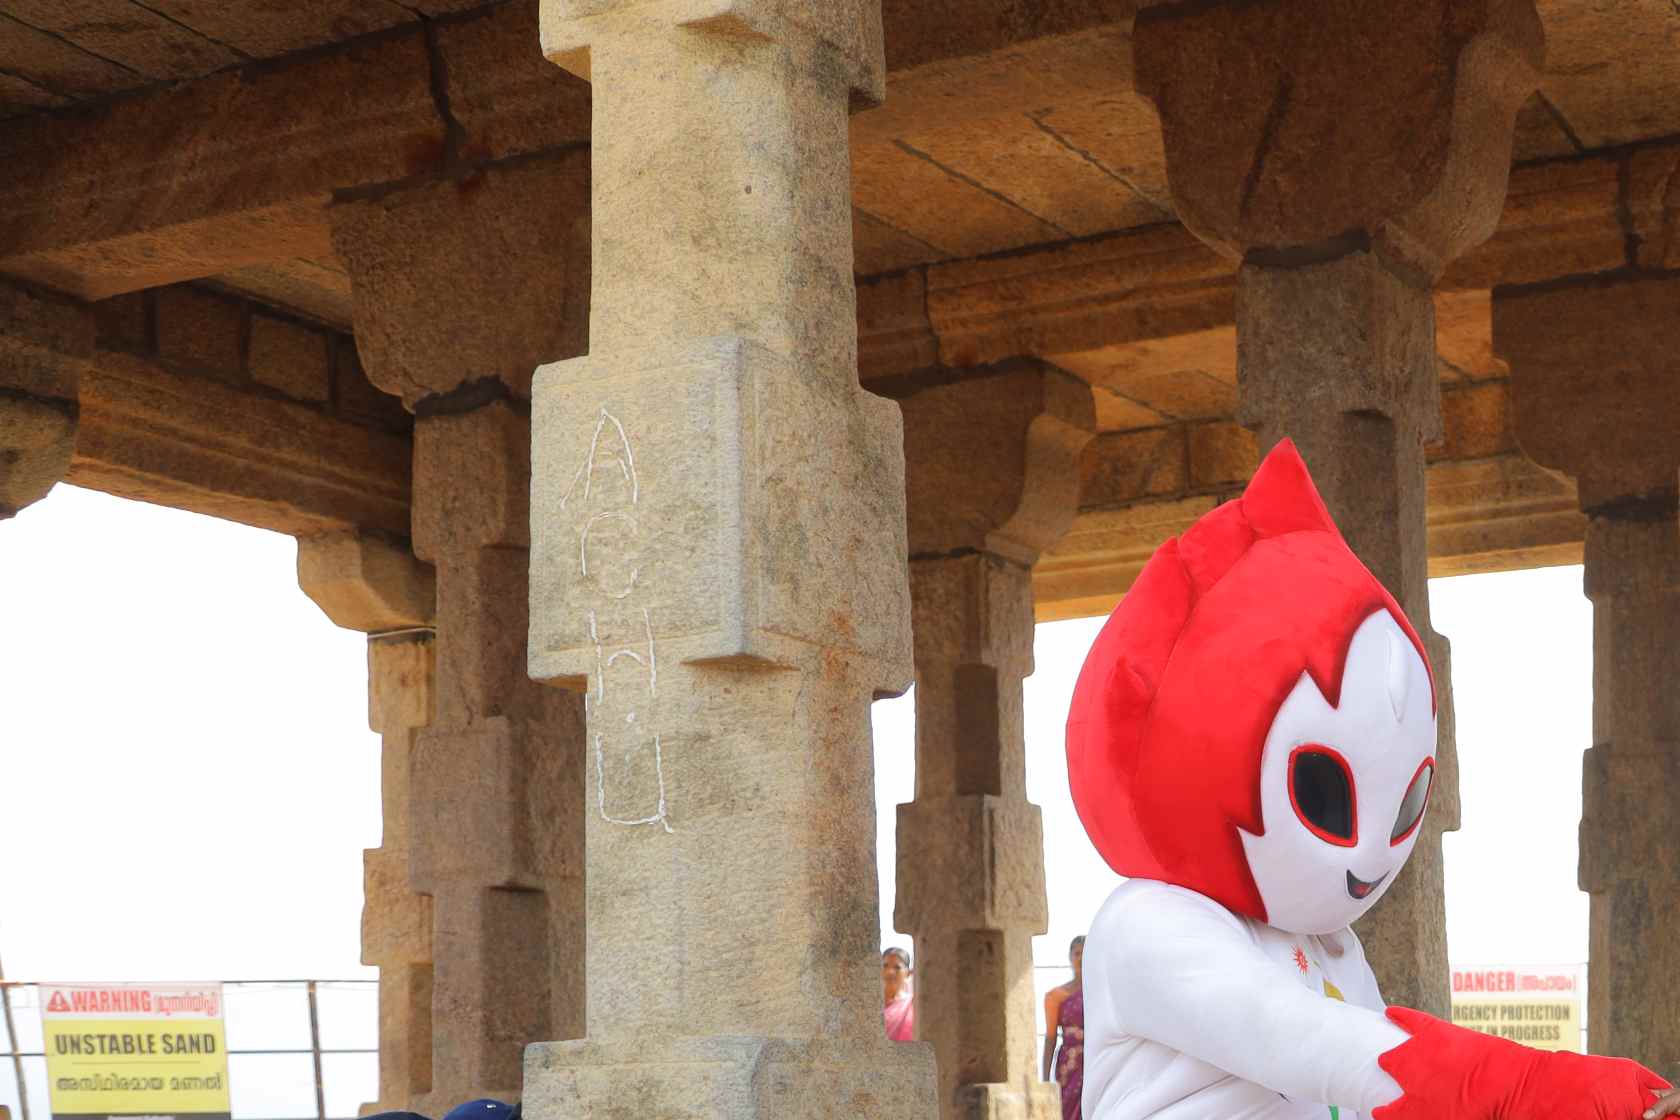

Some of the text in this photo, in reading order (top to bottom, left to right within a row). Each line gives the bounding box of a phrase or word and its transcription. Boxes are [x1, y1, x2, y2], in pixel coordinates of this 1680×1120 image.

[1453, 972, 1516, 992] DANGER
[70, 990, 152, 1013] WARNING
[1500, 1005, 1571, 1022] PROTECTION
[1502, 1025, 1560, 1041] PROGRESS
[54, 1033, 216, 1055] UNSTABLE SAND
